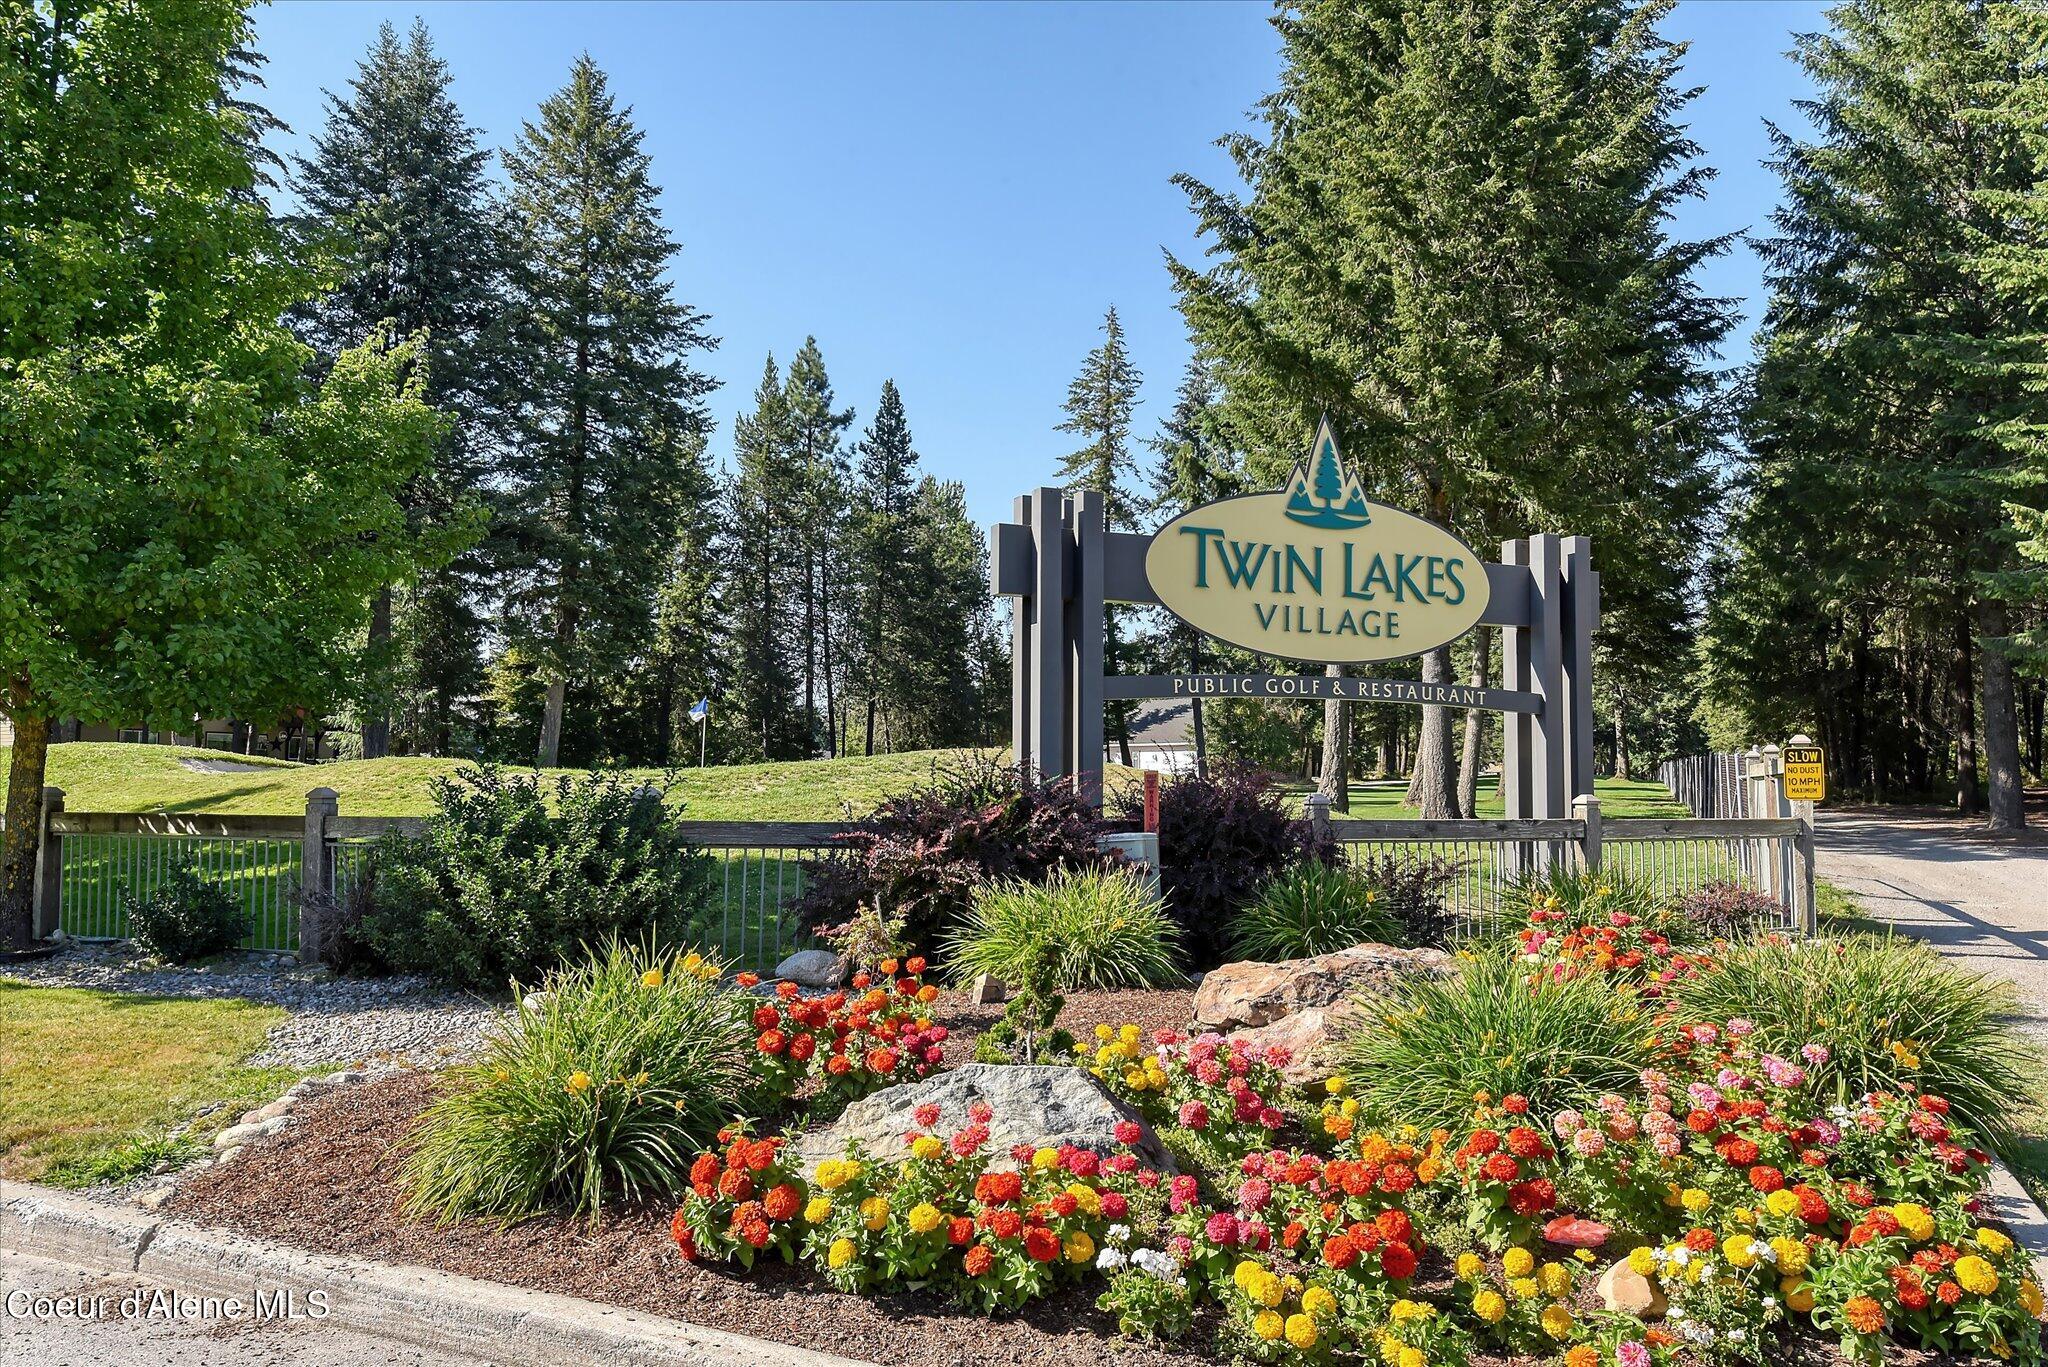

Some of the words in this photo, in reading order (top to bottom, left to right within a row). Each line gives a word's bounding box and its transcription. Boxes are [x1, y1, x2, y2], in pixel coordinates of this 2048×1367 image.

[1179, 526, 1324, 596] TWIN
[1343, 542, 1466, 605] LAKES
[1254, 603, 1400, 639] VILLAGE
[1173, 678, 1253, 694] PUBLIC
[1265, 678, 1321, 695] GOLF
[1332, 681, 1346, 696] &
[1358, 682, 1487, 705] RESTAURANT
[1788, 751, 1818, 762] SLOW
[1788, 778, 1798, 786] 10
[1800, 778, 1820, 786] MPH
